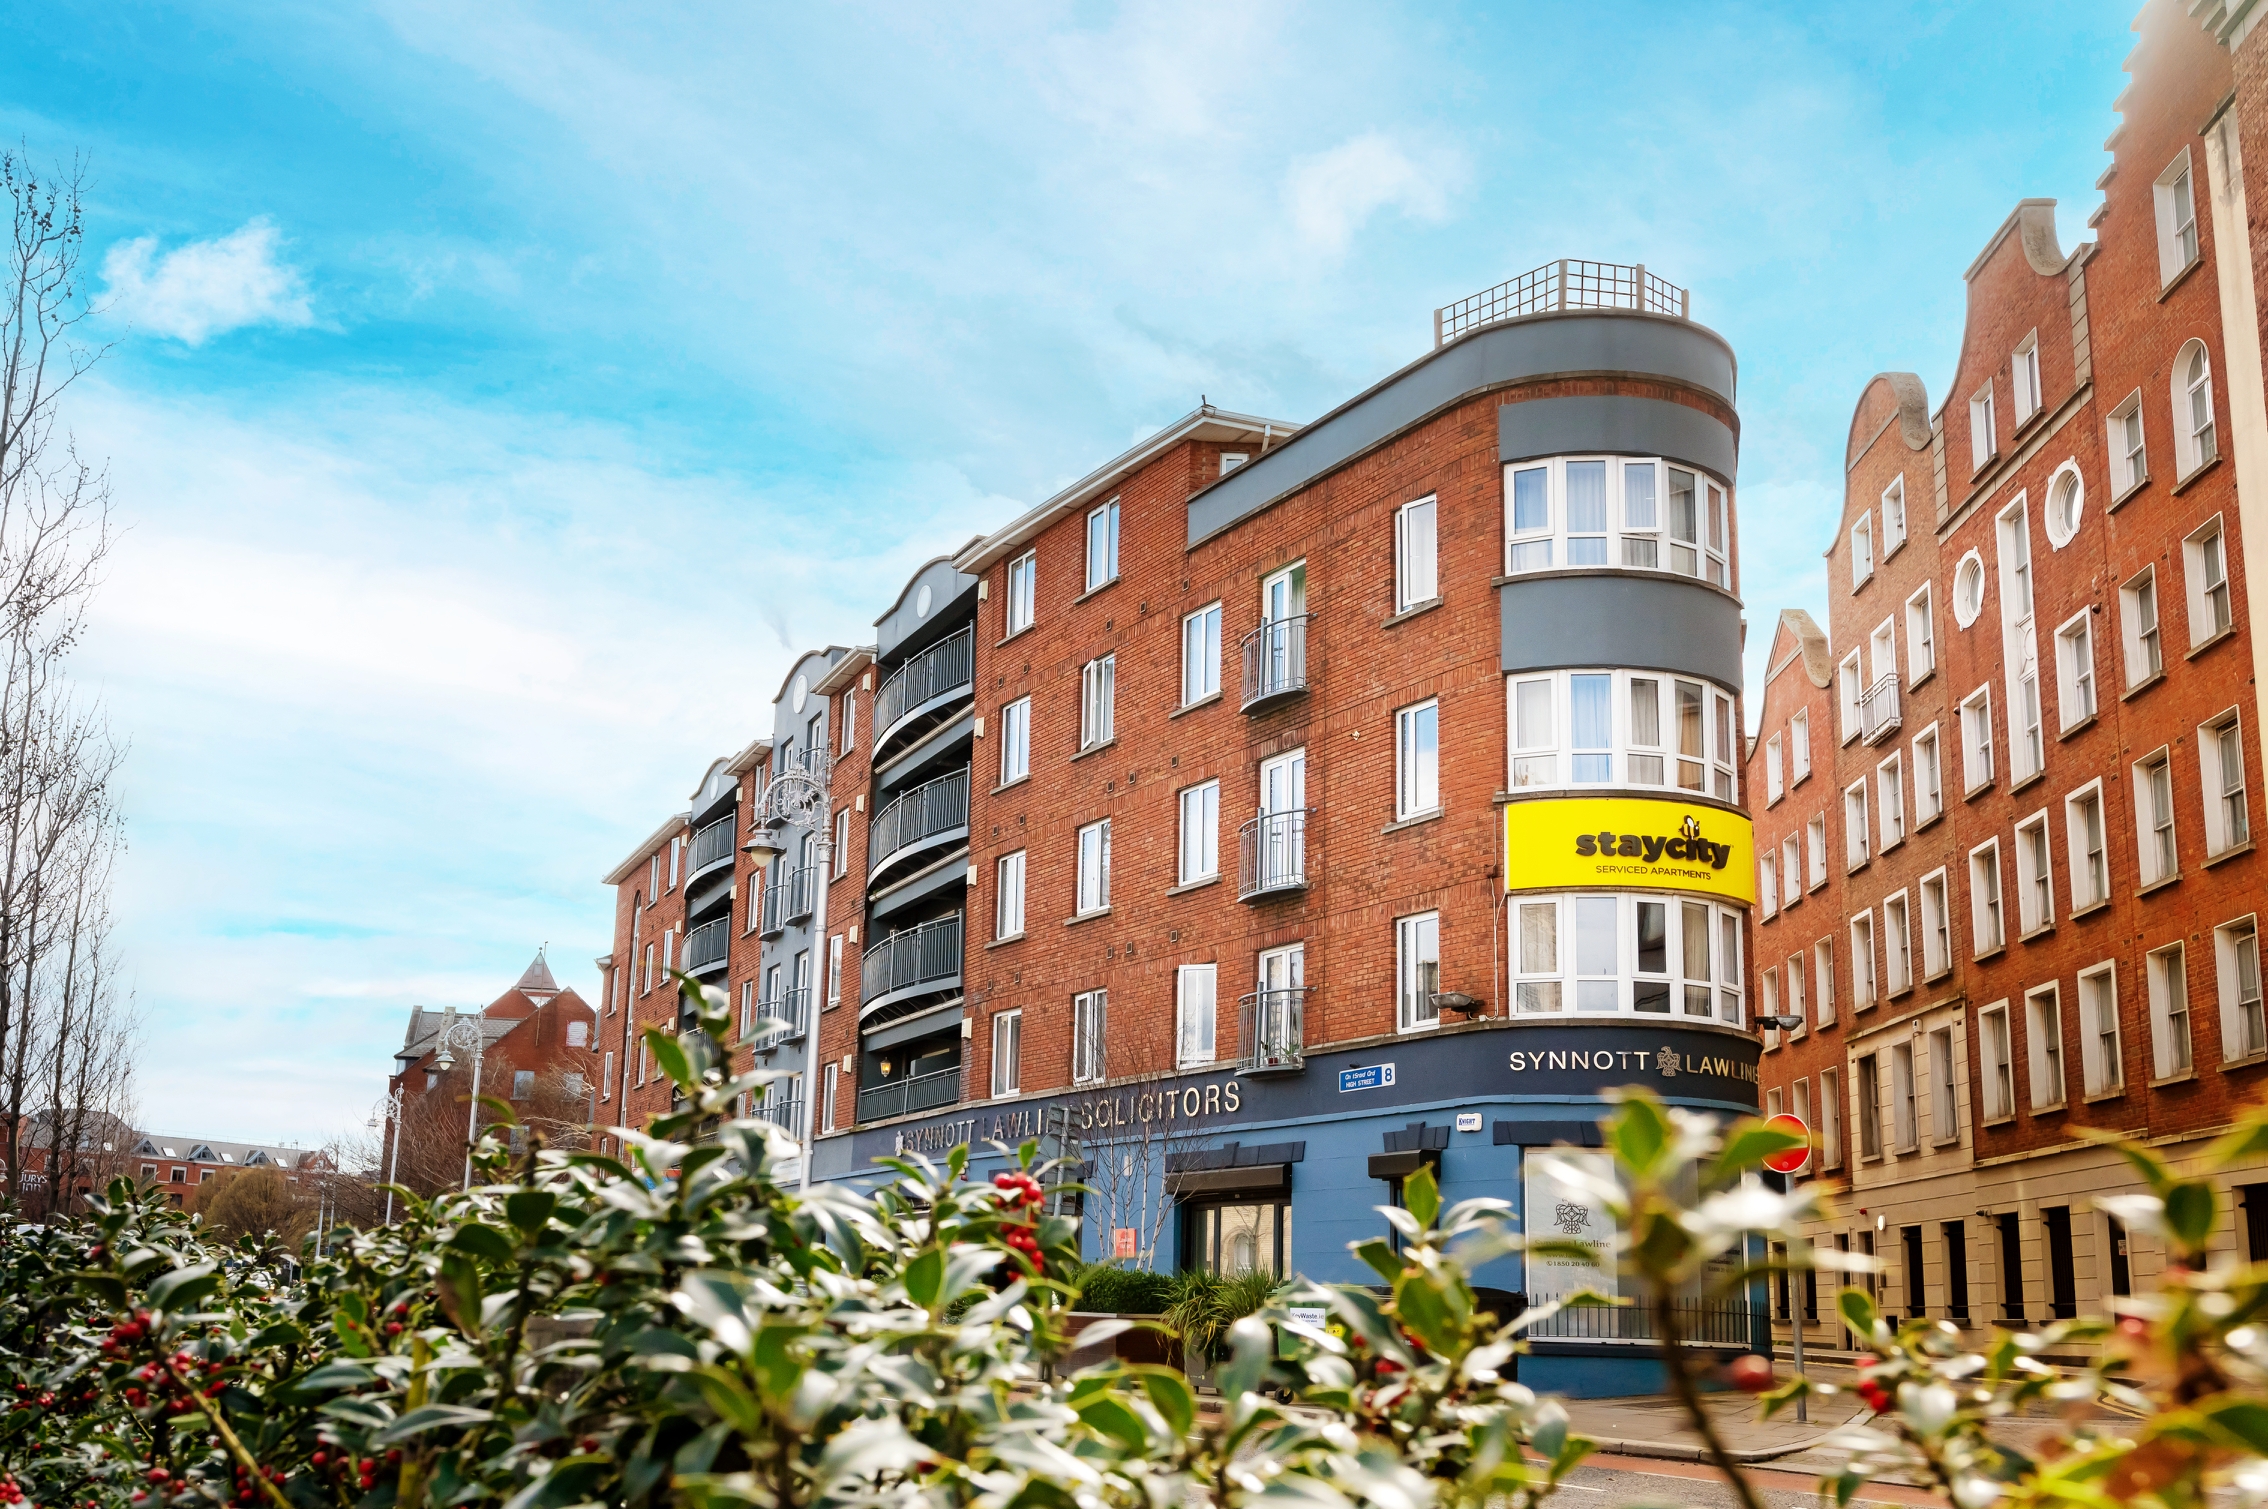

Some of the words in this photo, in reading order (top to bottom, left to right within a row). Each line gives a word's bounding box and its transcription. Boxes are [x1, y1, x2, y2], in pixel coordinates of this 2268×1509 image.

[1575, 831, 1731, 870] staycity
[1595, 865, 1648, 875] SERVICED
[1650, 867, 1712, 881] APARTMENTS
[1509, 1050, 1650, 1071] SYNNOTT
[1357, 1078, 1375, 1087] STREET
[1385, 1068, 1392, 1082] 8
[905, 1119, 975, 1152] SYNNOTT
[981, 1108, 1050, 1142] LAWLI
[1081, 1081, 1240, 1130] SOLICITORS
